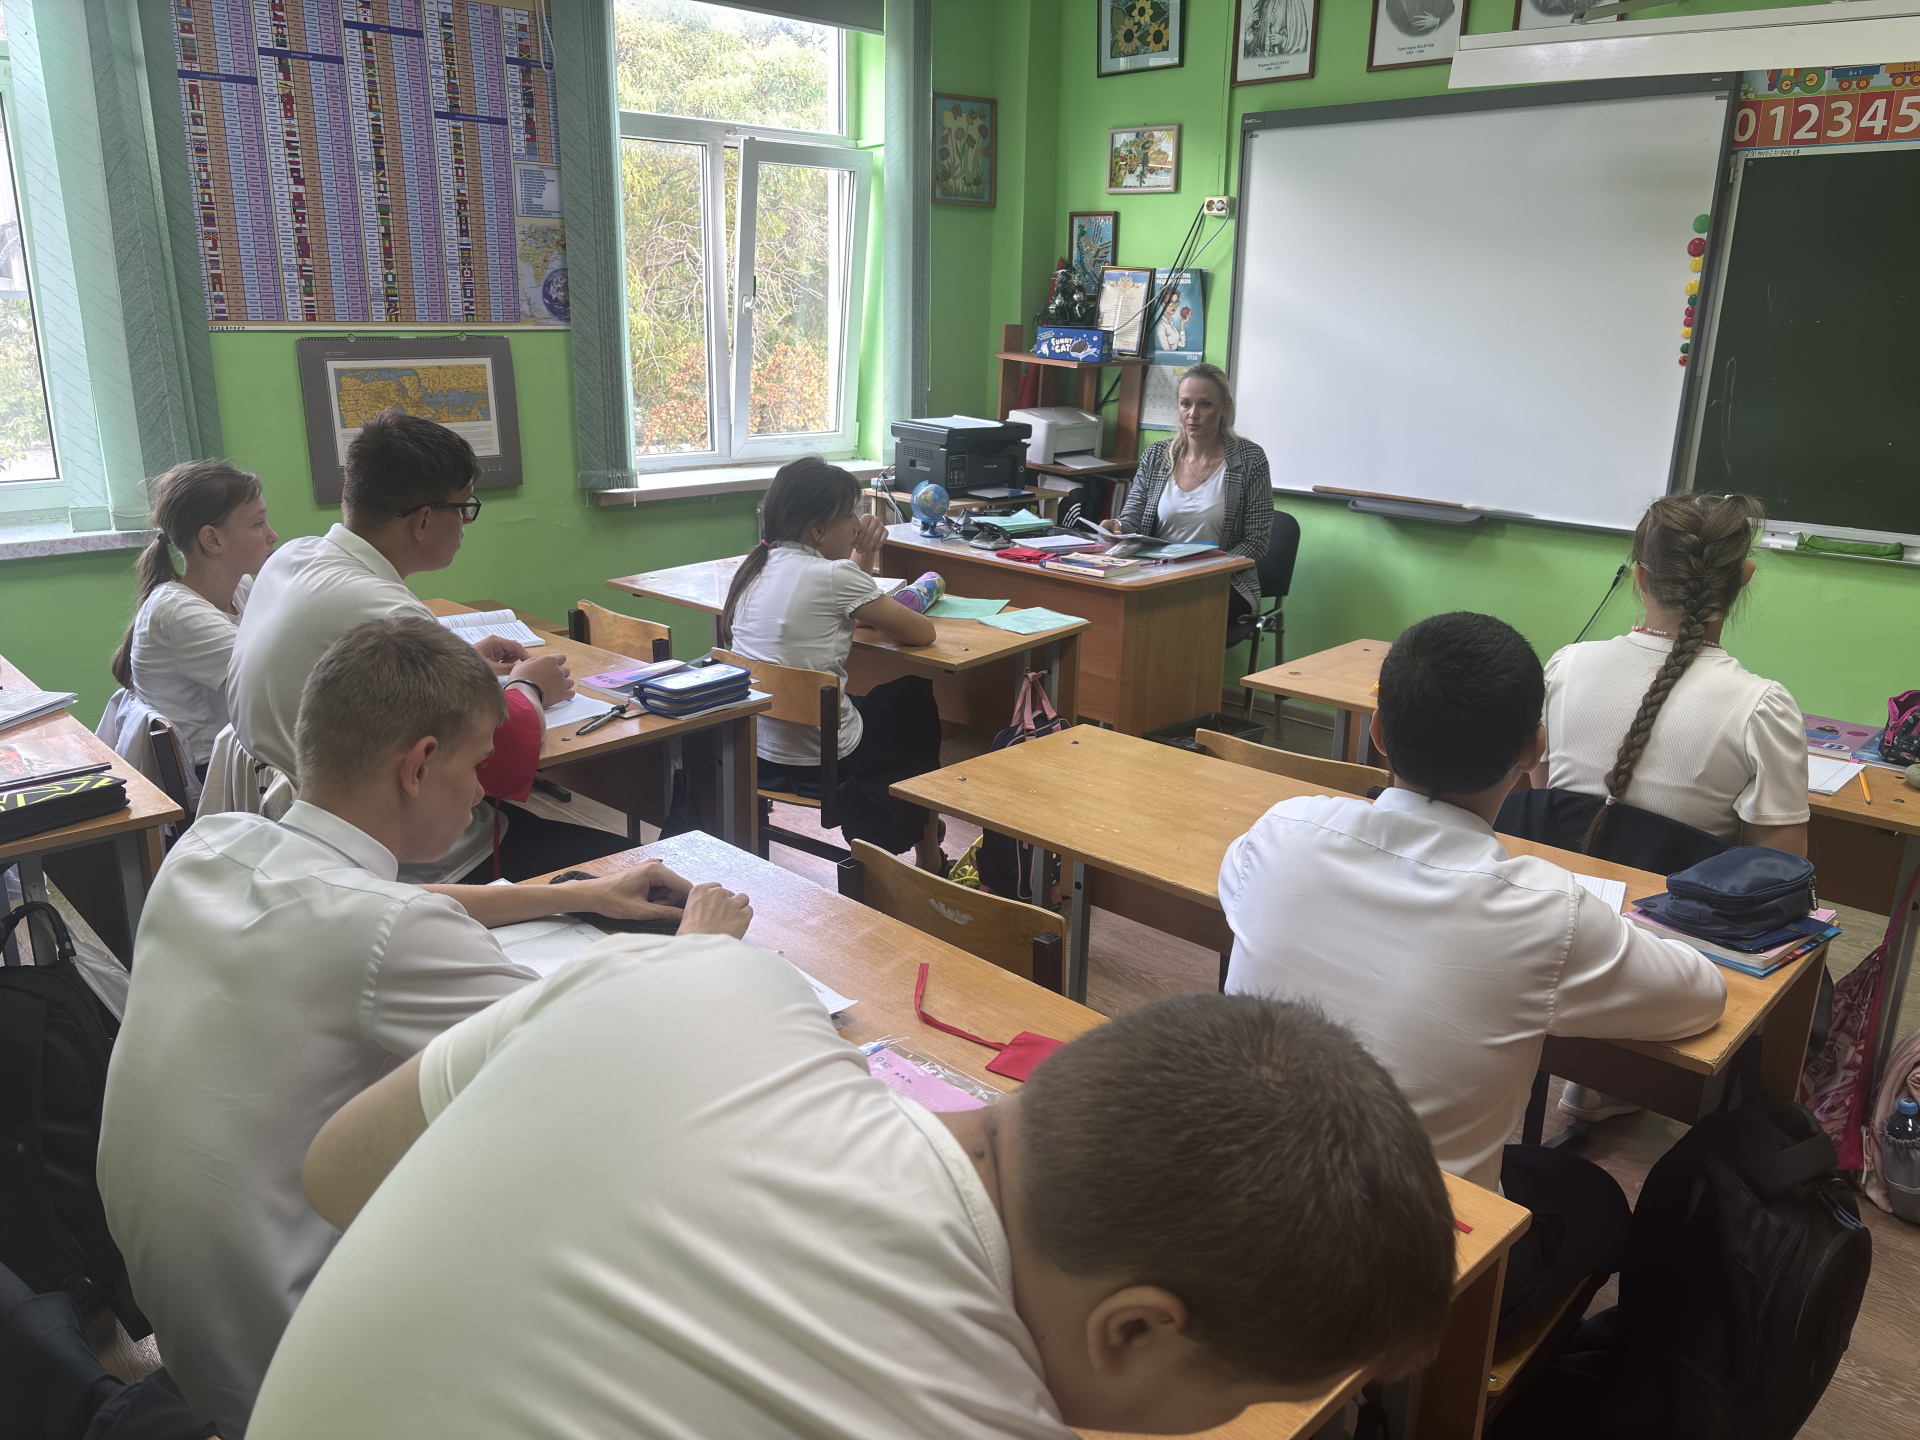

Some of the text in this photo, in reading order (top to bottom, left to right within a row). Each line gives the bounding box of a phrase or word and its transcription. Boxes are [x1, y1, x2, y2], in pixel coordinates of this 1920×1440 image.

[1734, 95, 1920, 142] 0 1 2 3 4 5
[1050, 337, 1074, 346] FUNNY
[1054, 344, 1072, 353] CAT
